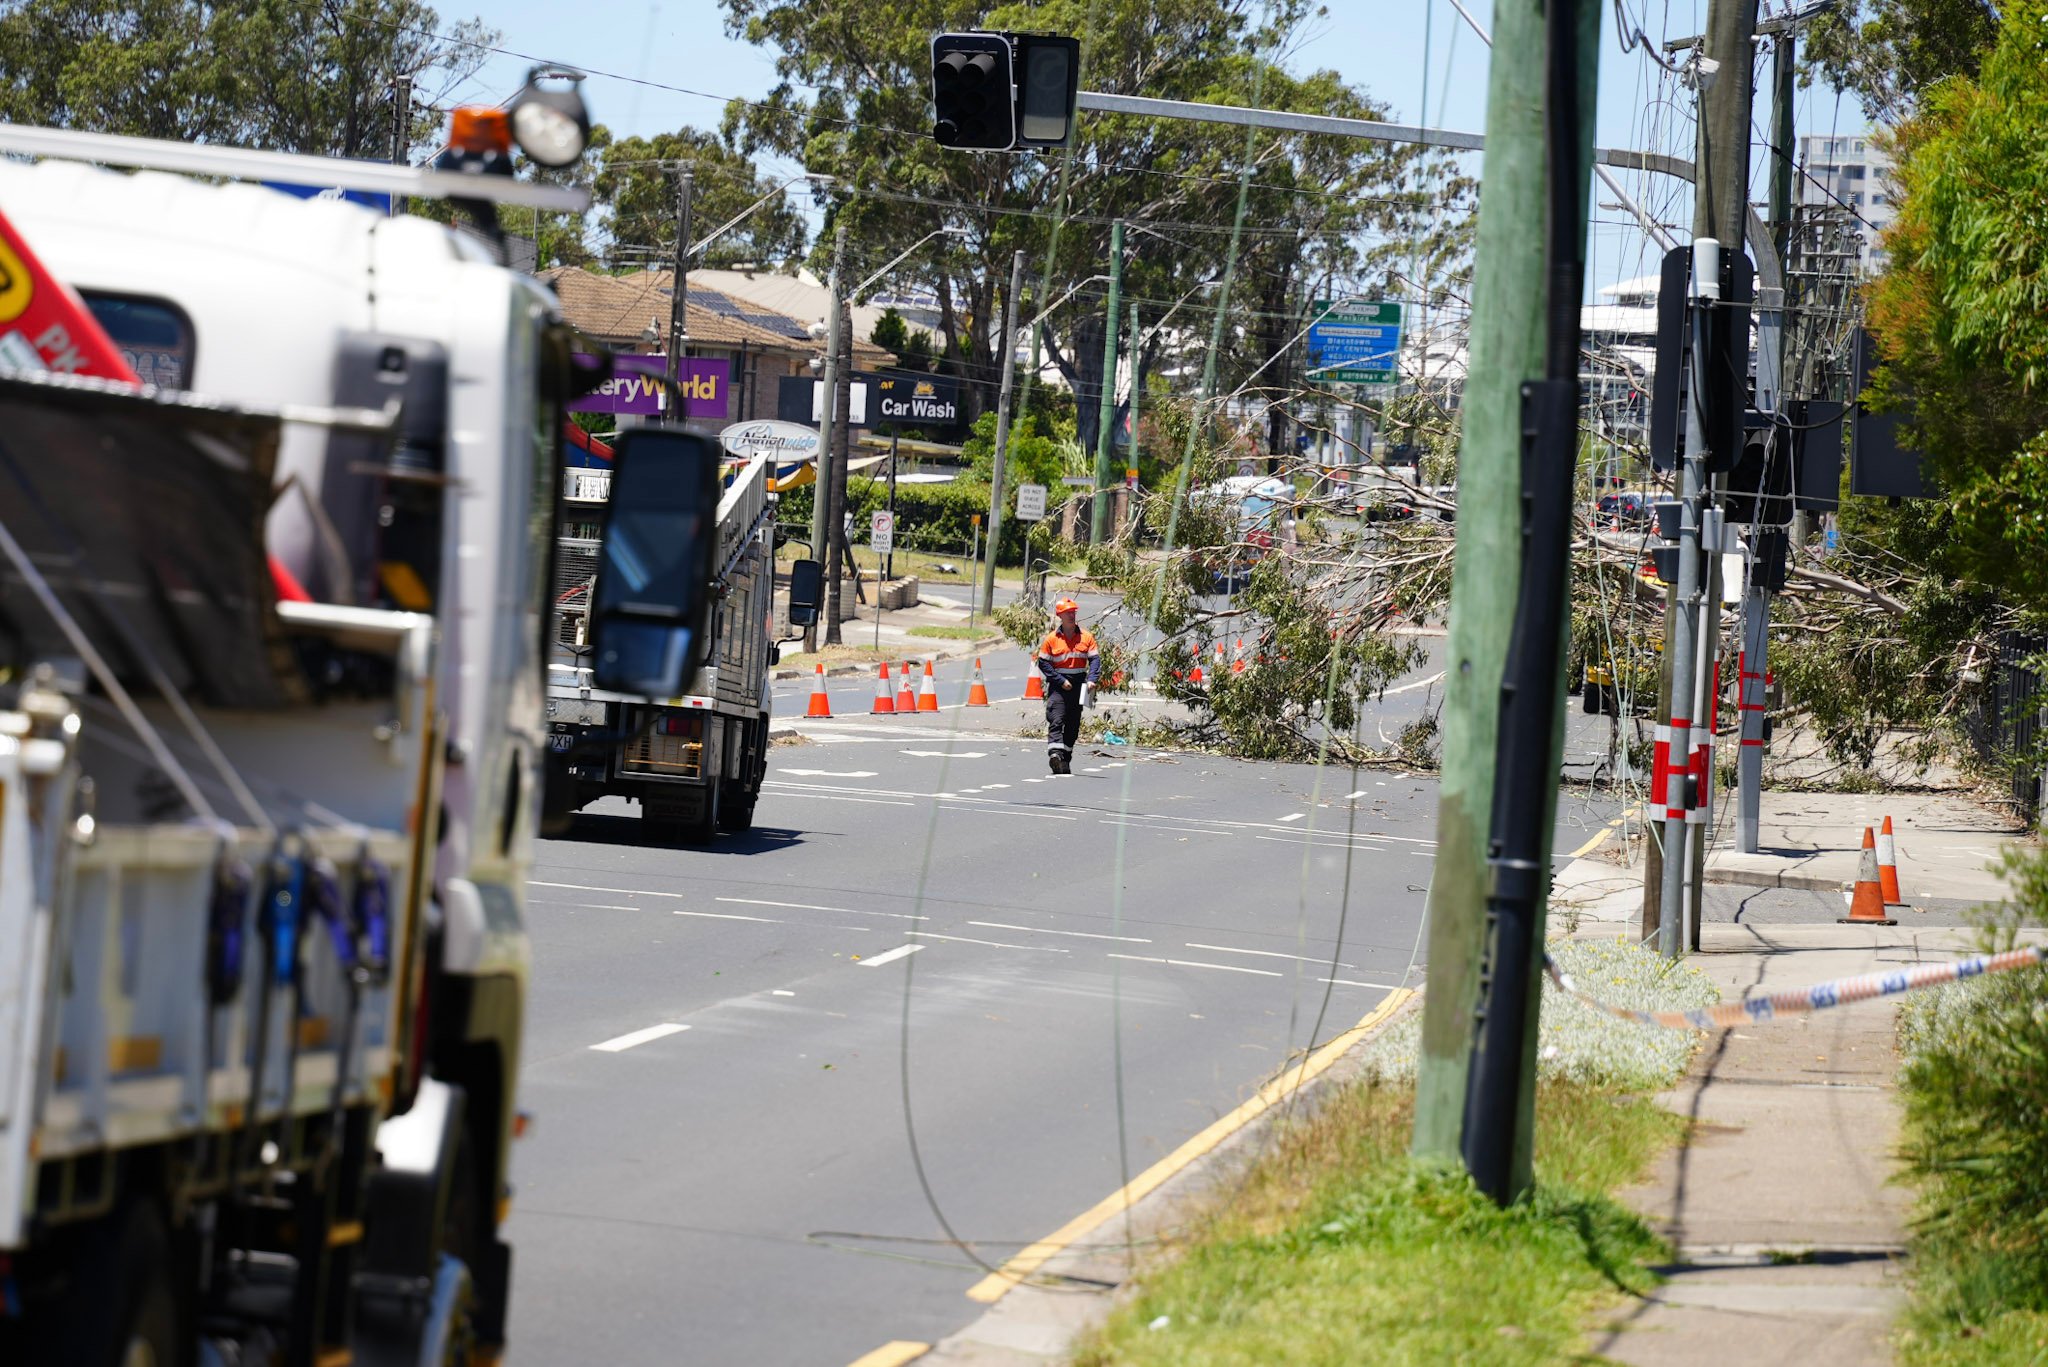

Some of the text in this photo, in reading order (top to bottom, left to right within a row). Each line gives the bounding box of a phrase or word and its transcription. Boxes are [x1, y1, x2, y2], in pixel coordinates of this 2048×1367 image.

[881, 398, 955, 418] Car Wash
[742, 431, 817, 449] Nationwide
